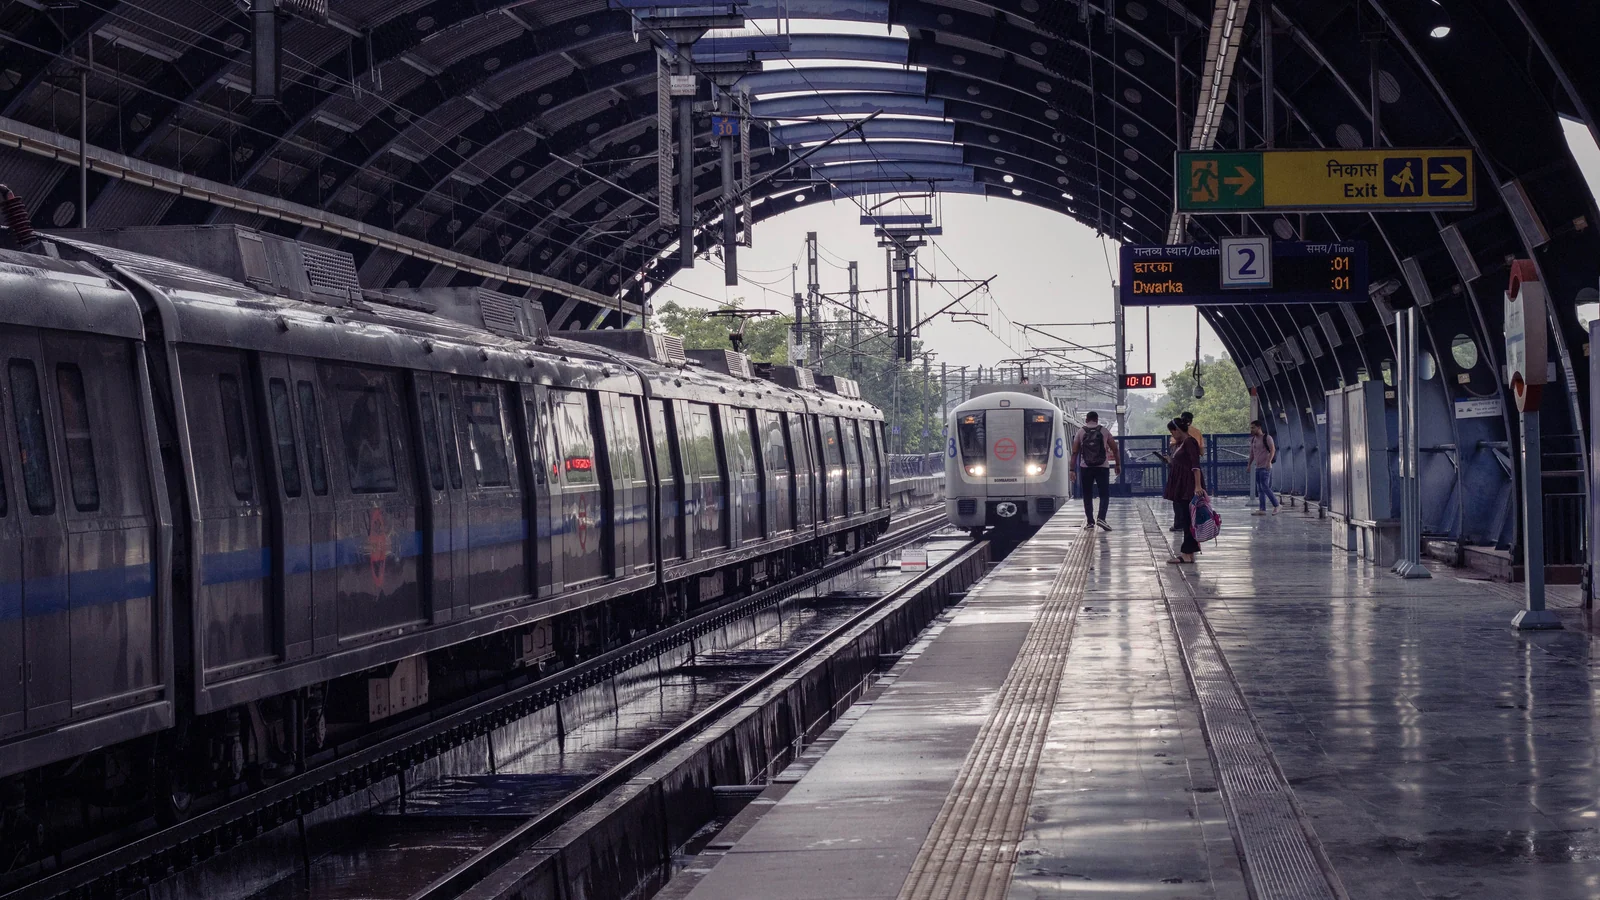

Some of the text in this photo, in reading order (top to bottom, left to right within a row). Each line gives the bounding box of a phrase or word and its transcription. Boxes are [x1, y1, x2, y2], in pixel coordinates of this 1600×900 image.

[719, 124, 733, 135] 30
[1326, 160, 1378, 180] निकास
[1344, 183, 1378, 198] Exit
[1134, 247, 1162, 257] गन्तव्य
[1133, 262, 1173, 273] द्वारका
[1237, 248, 1257, 275] 2
[1330, 257, 1349, 270] :01
[1133, 280, 1183, 294] Dwarka
[1331, 276, 1350, 290] :01
[1126, 375, 1152, 387] 10:10
[948, 437, 957, 458] 8
[1054, 437, 1063, 458] 8
